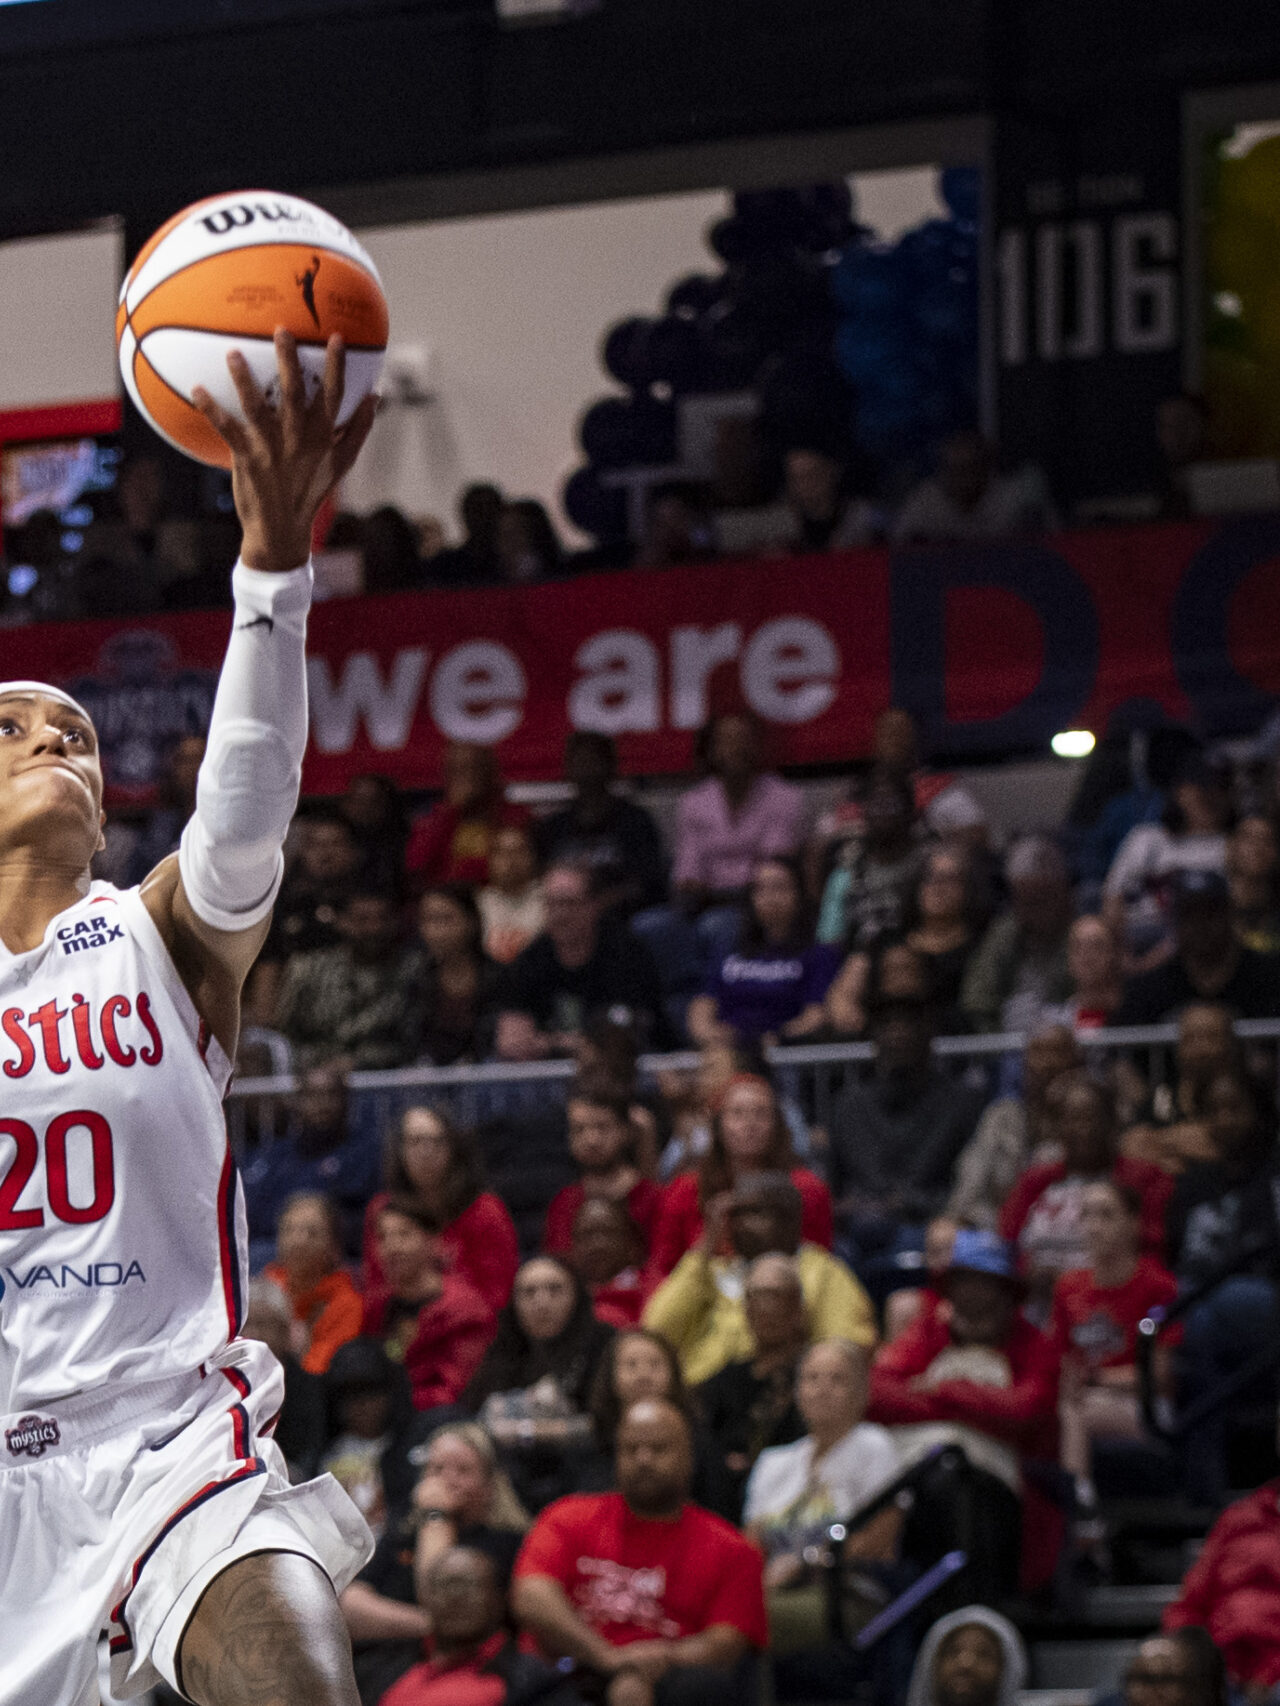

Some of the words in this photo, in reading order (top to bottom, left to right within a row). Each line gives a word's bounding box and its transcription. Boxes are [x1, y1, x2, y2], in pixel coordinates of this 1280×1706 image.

[999, 212, 1176, 363] 106
[307, 637, 526, 755] we
[567, 613, 839, 733] are
[57, 915, 108, 941] CAR
[62, 924, 125, 955] max
[5, 1260, 147, 1289] VANDA
